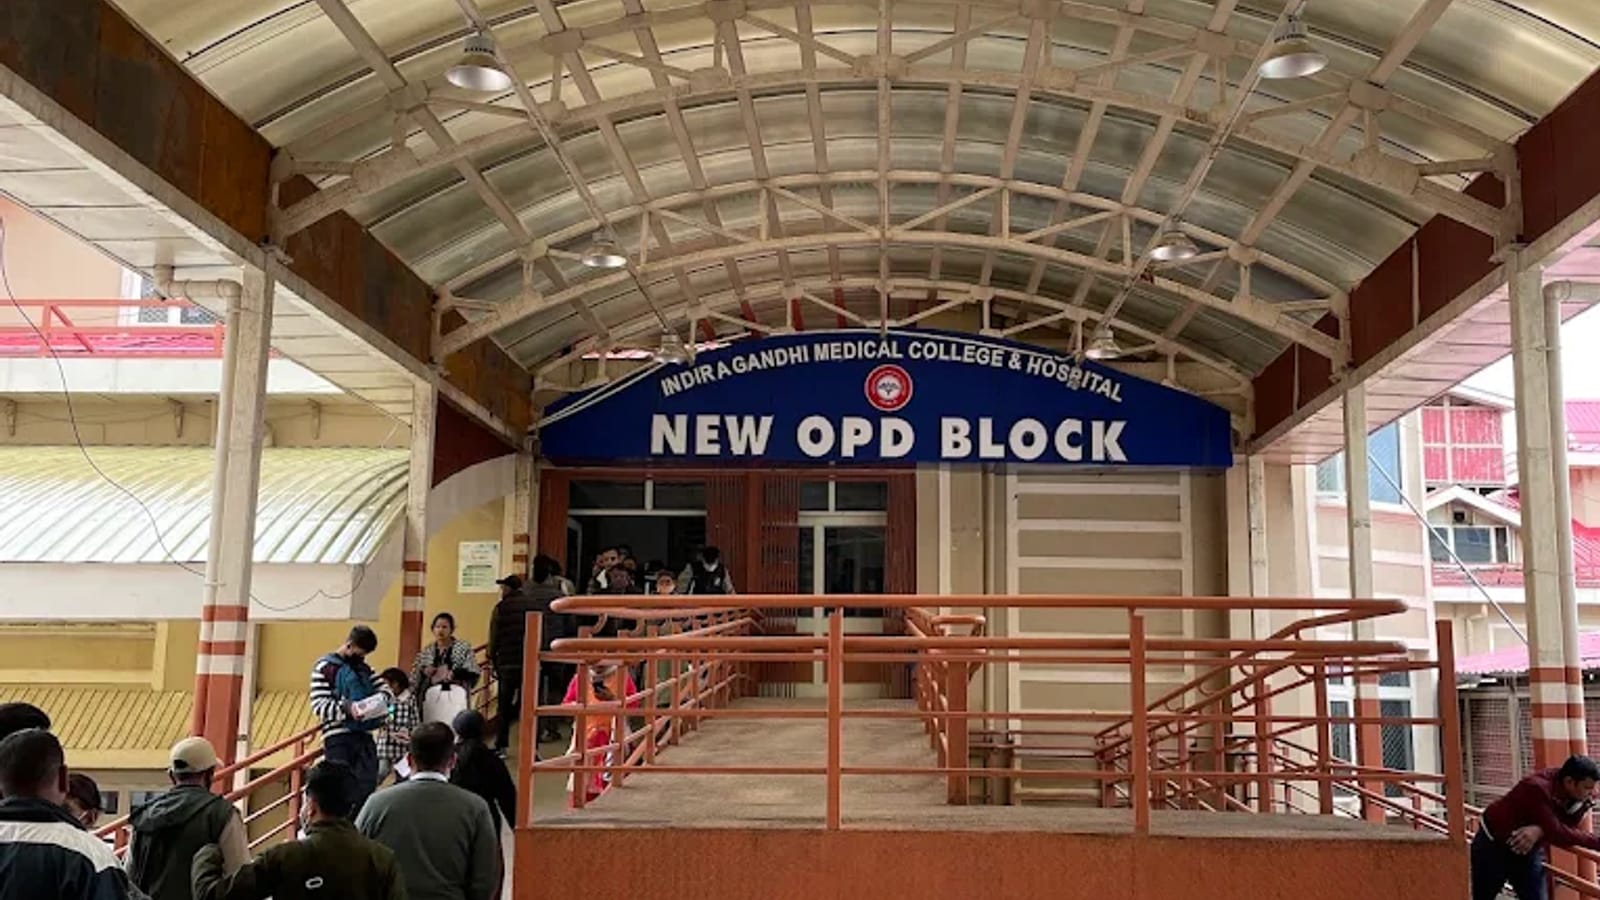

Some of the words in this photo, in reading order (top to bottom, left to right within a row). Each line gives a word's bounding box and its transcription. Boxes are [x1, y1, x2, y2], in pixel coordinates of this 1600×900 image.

[661, 360, 732, 397] INDIRA
[732, 345, 809, 372] GANDHI
[814, 340, 903, 361] MEDICAL
[909, 341, 1003, 367] COLLEGE
[1008, 352, 1022, 370] &
[1026, 356, 1123, 402] HOSPITAL
[651, 414, 774, 456] NEW
[797, 416, 915, 458] OPD
[941, 417, 1128, 462] BLOCK
